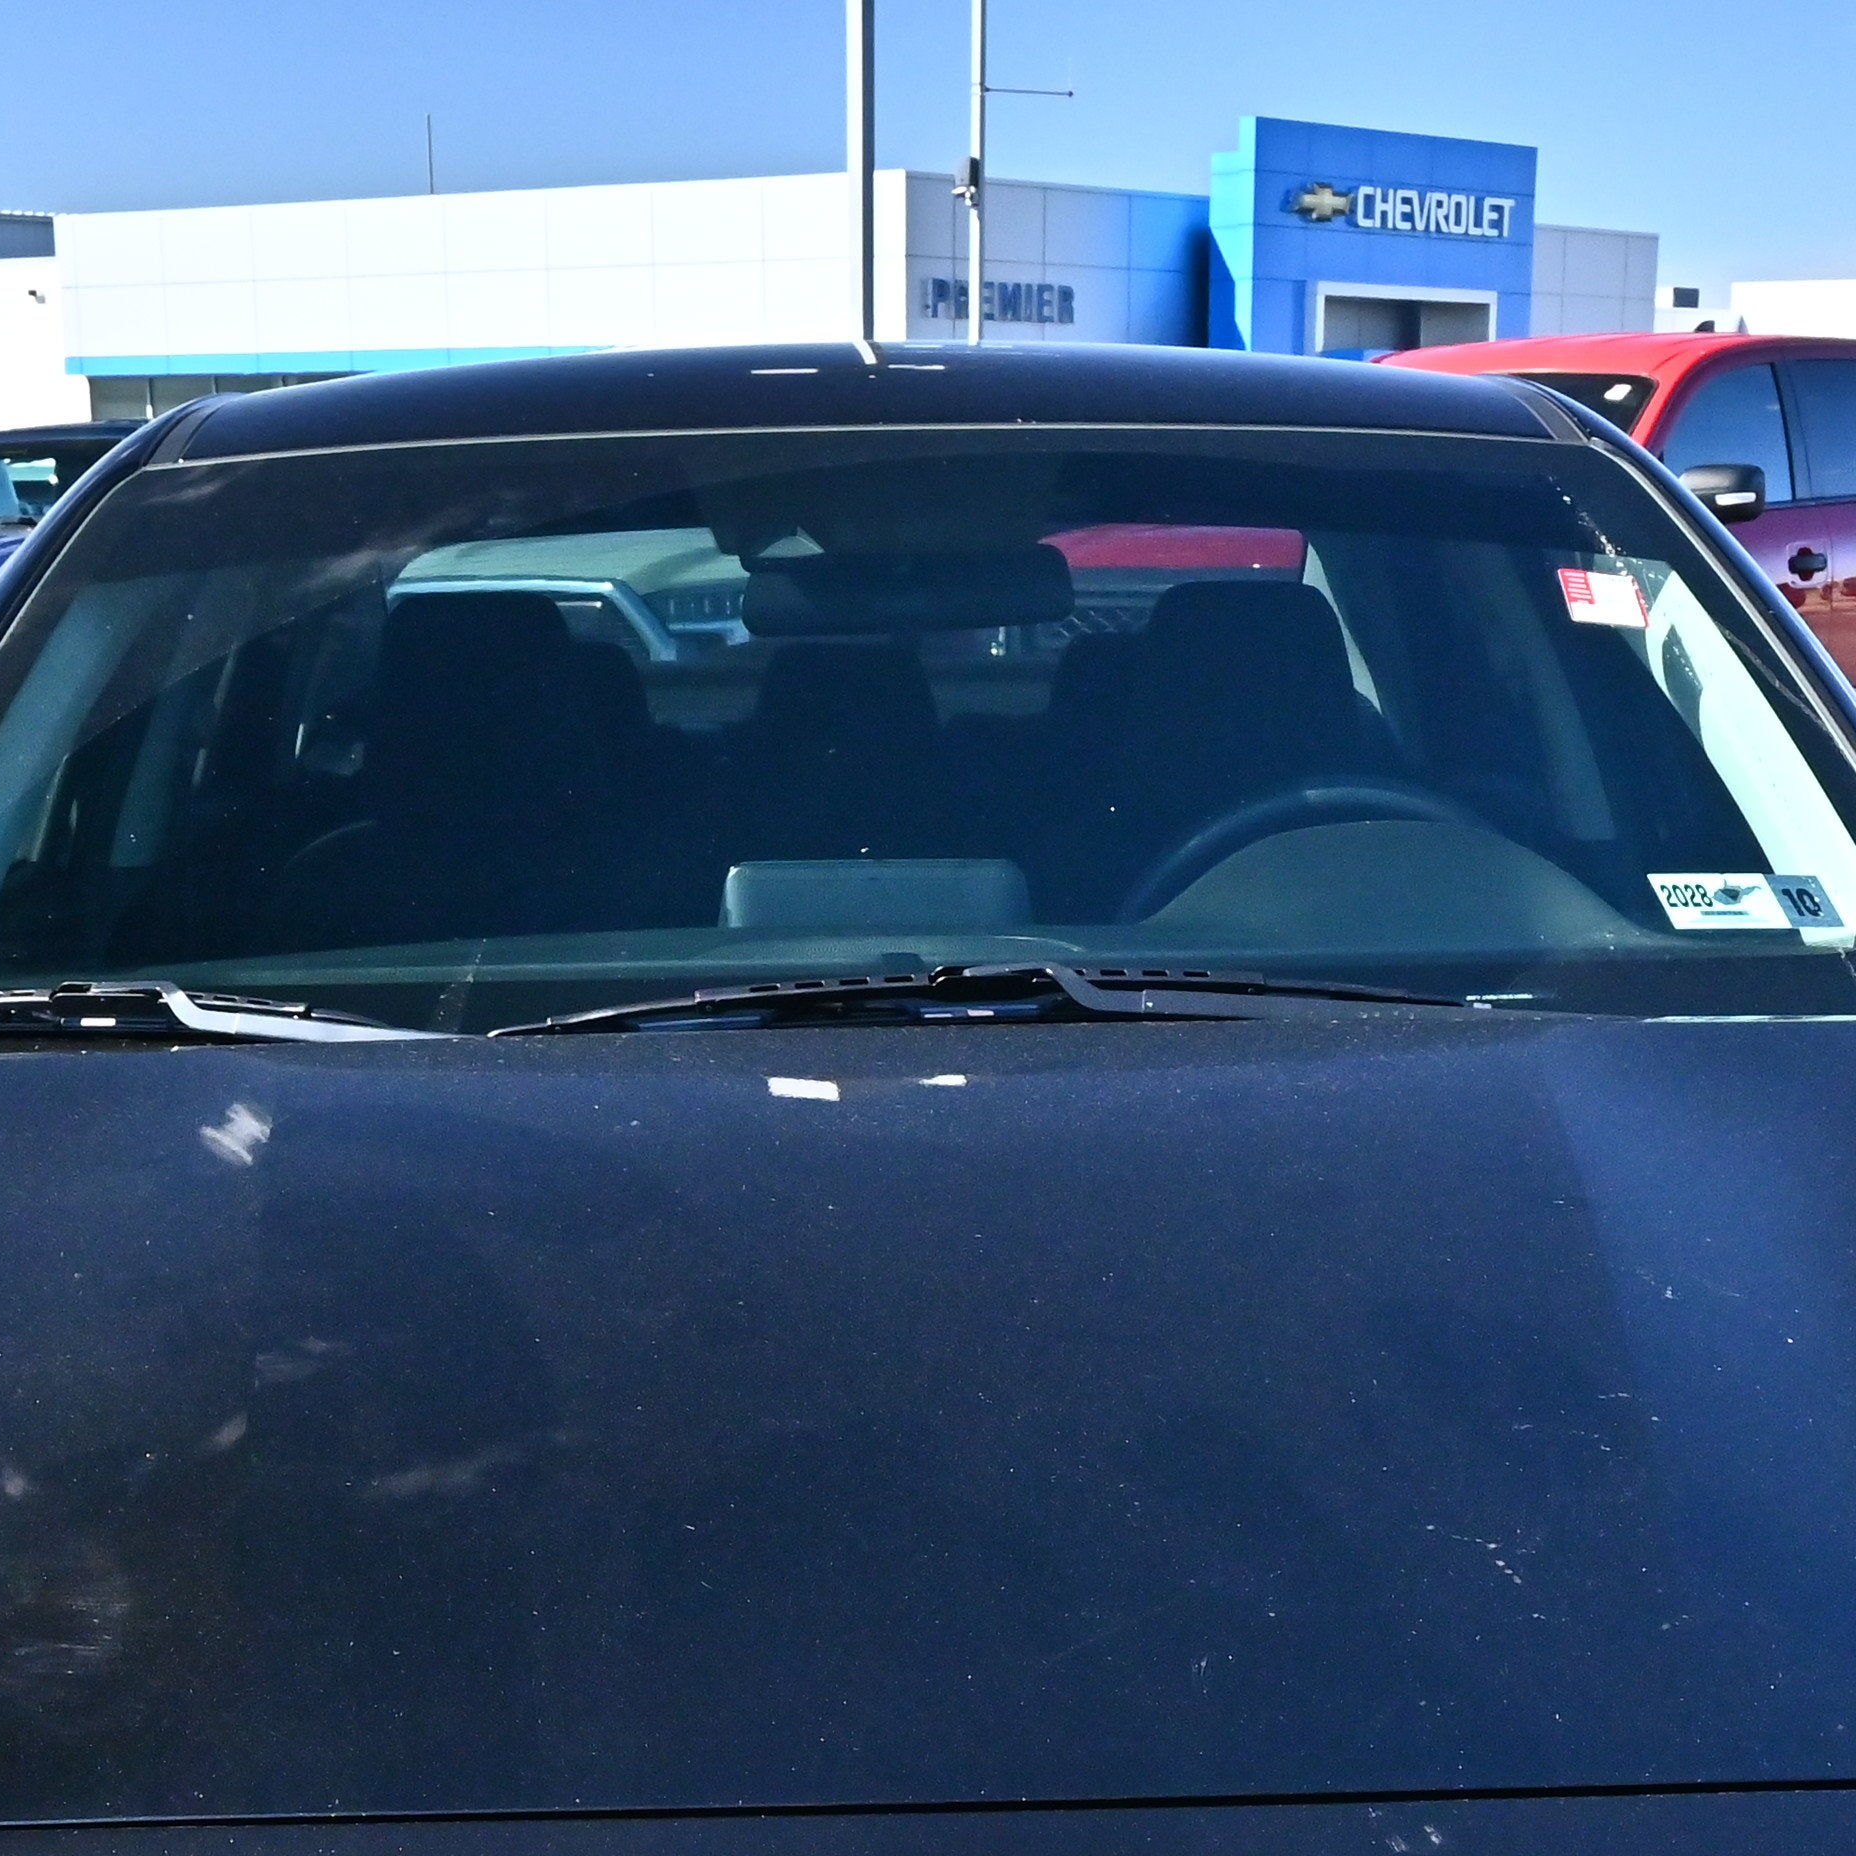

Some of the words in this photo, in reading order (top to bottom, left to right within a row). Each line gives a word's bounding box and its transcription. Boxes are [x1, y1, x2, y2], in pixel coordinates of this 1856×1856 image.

[1357, 185, 1515, 237] CHEVROLET
[1660, 884, 1713, 907] 2028
[1781, 888, 1822, 917] 10
